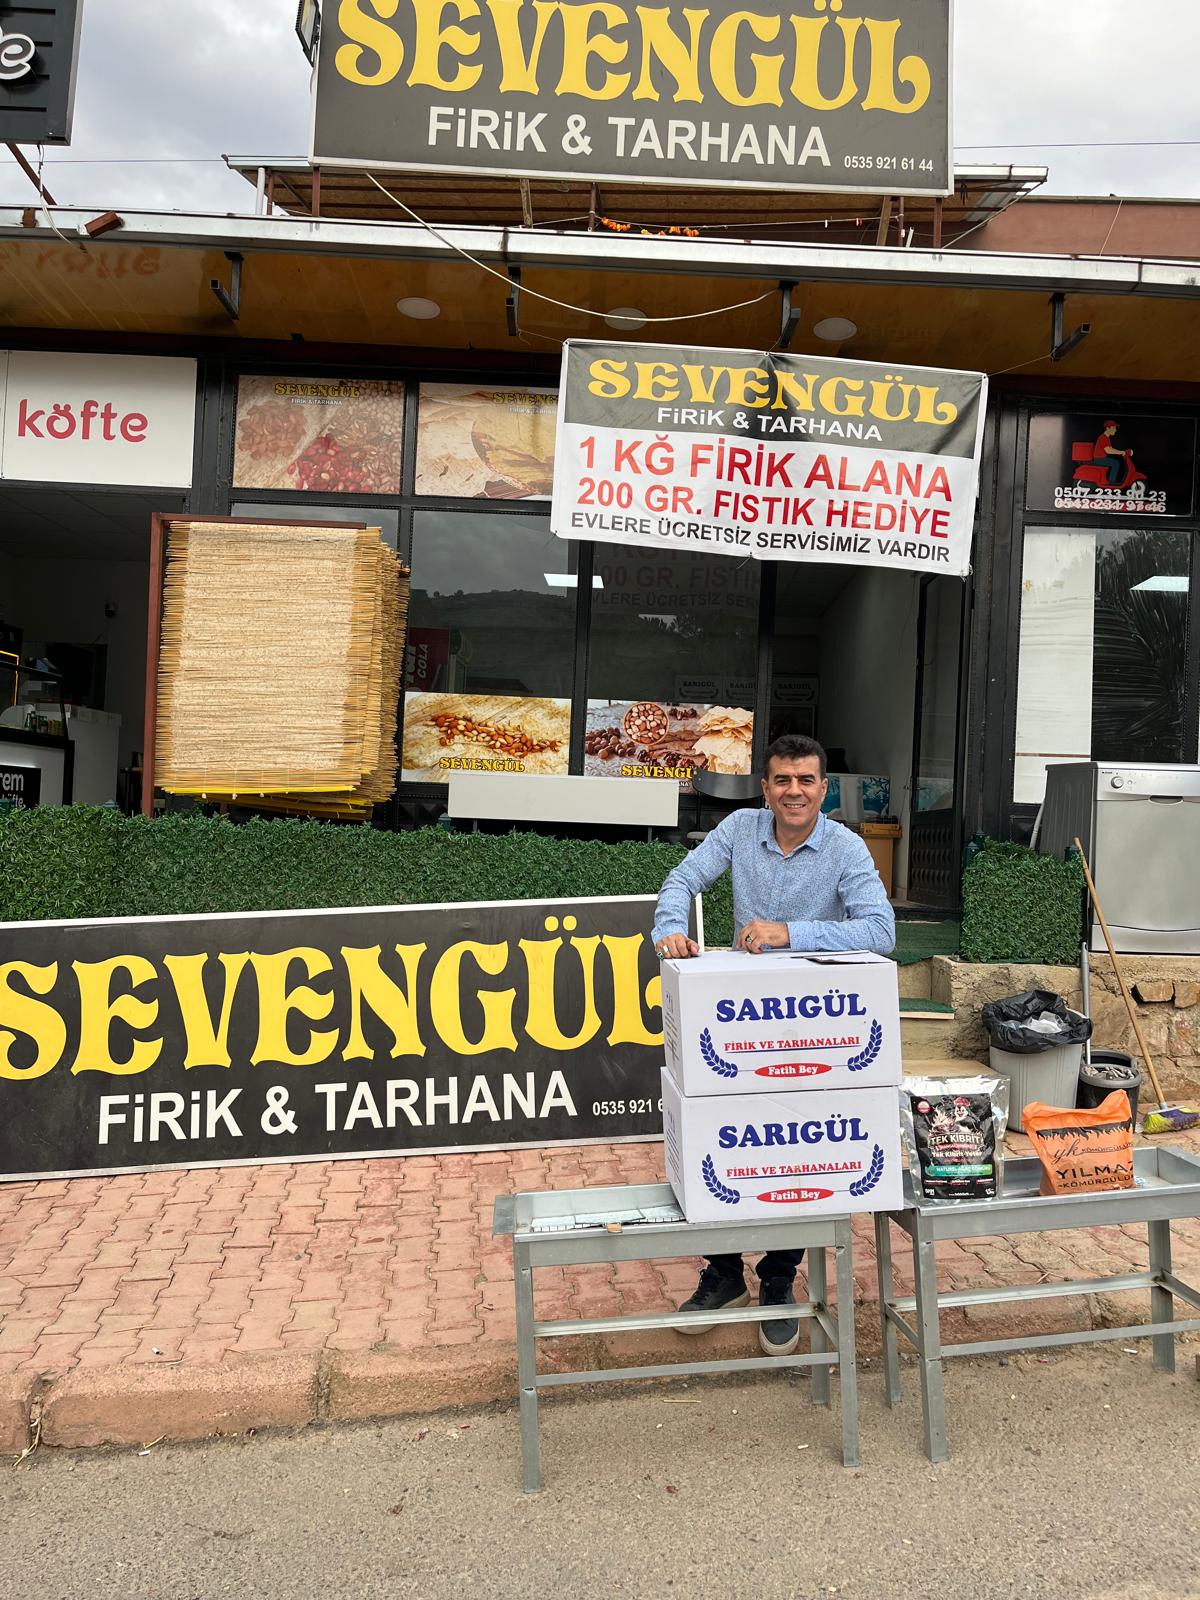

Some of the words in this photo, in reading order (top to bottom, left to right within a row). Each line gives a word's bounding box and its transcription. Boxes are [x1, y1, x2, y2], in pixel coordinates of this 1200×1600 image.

[335, 0, 931, 113] SEVENGÜL
[561, 114, 593, 156] &
[608, 116, 831, 167] TARHANA
[844, 156, 874, 170] 0535
[876, 156, 897, 170] 921
[900, 157, 915, 171] 61
[917, 158, 934, 172] 44
[588, 359, 958, 425] SEVENGÜL
[17, 398, 149, 443] köfte
[732, 411, 750, 430] &
[757, 415, 883, 442] TARHANA
[579, 435, 596, 469] 1
[614, 433, 675, 476] KĞ
[690, 437, 800, 489] FİRİK
[803, 455, 953, 502] ALANA
[576, 476, 633, 509] 200
[644, 483, 702, 516] GR.
[713, 490, 815, 528] FISTIK
[827, 496, 951, 539] HEDİYE
[1095, 488, 1122, 499] 233
[1148, 491, 1166, 501] 23
[571, 512, 651, 536] EVLERE
[658, 517, 751, 547] ÜCRETSİZ
[756, 531, 872, 554] SERVİSİMİZ
[877, 539, 951, 563] VARDIR
[439, 756, 526, 773] SEVENGÜL
[620, 763, 693, 780] SEVENG
[0, 915, 664, 1081] SEVENGÜL
[716, 989, 867, 1023] SARIGÜL
[759, 1040, 775, 1050] VE
[777, 1036, 861, 1049] TARHANALARI
[768, 1064, 797, 1076] Fatih
[799, 1064, 819, 1076] Bey
[260, 1085, 299, 1135] &
[314, 1069, 578, 1132] TARHANA
[592, 1100, 626, 1116] 0535
[629, 1098, 652, 1114] 921
[718, 1113, 868, 1149] SARIGÜL
[931, 1135, 949, 1145] TEK
[761, 1166, 777, 1176] VE
[781, 1161, 862, 1174] TARHANALARI
[770, 1190, 799, 1201] Fatih
[801, 1190, 821, 1201] Bey
